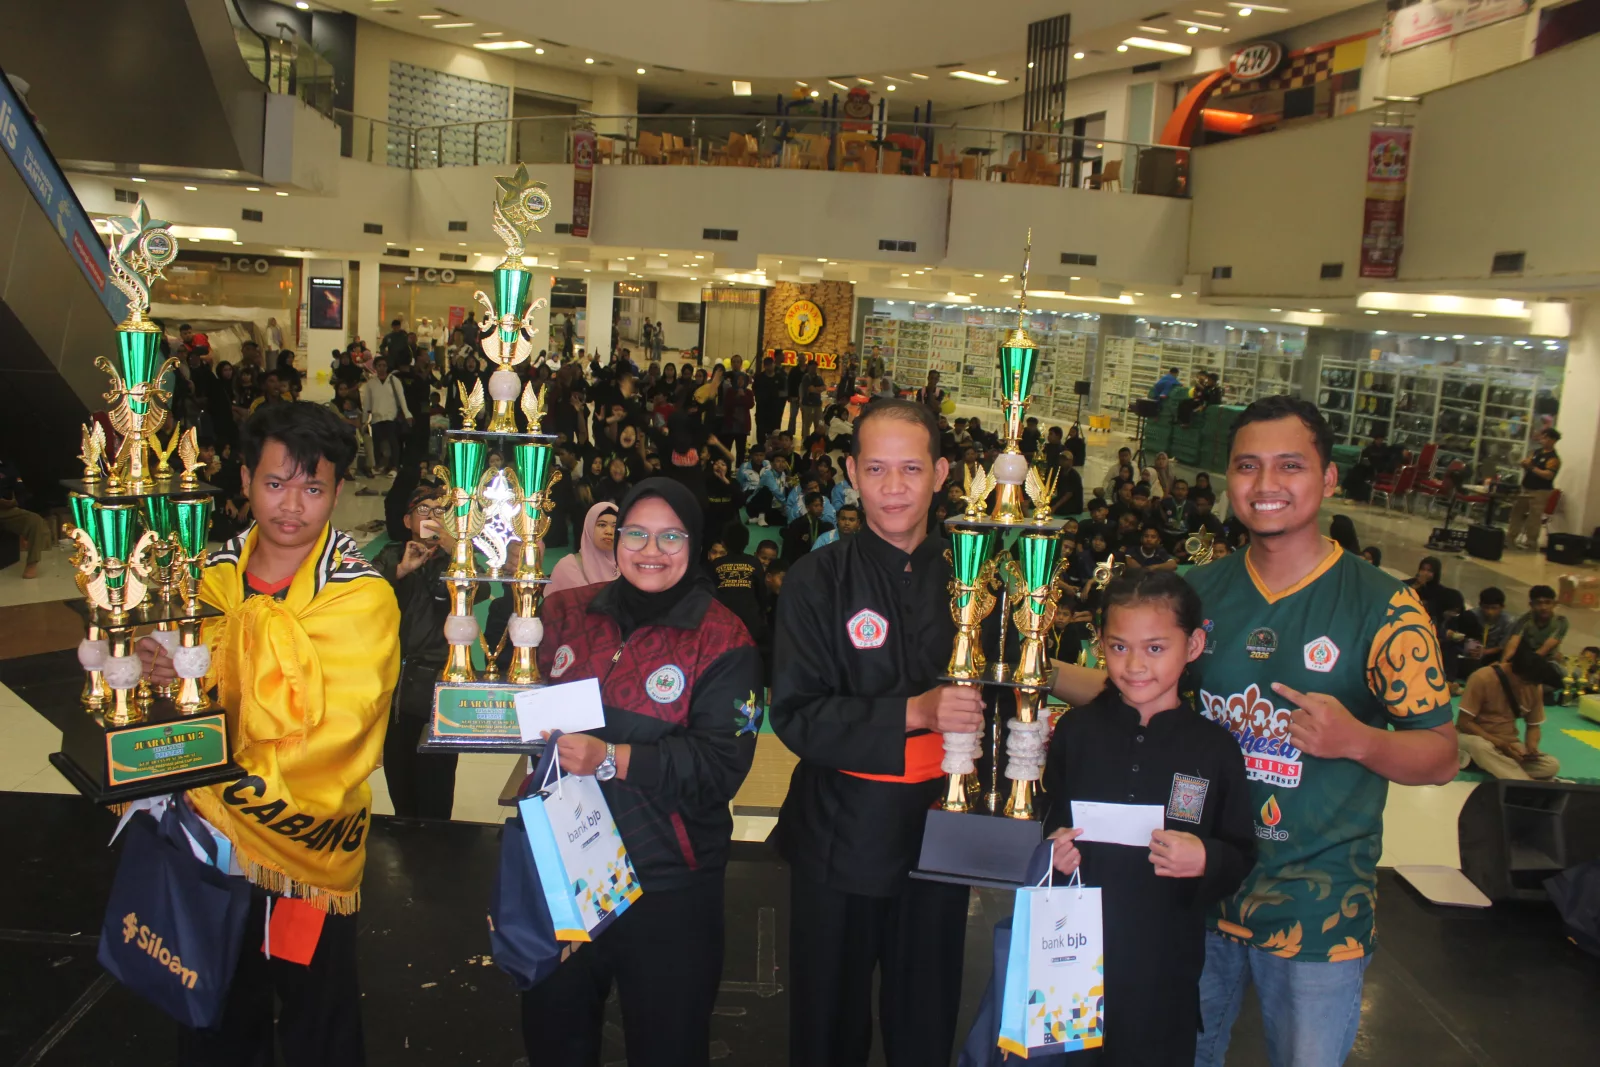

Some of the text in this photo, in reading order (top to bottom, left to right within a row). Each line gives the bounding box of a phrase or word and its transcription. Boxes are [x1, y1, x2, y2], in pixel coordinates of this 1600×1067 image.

[1250, 651, 1269, 659] 2026
[458, 700, 487, 708] JUARA
[134, 731, 204, 751] JUARA UMUM 3
[1265, 774, 1297, 785] JERSEY
[223, 775, 367, 852] CABANG
[567, 820, 588, 843] bank
[587, 810, 601, 827] bjb
[1042, 933, 1087, 950] bank bjb
